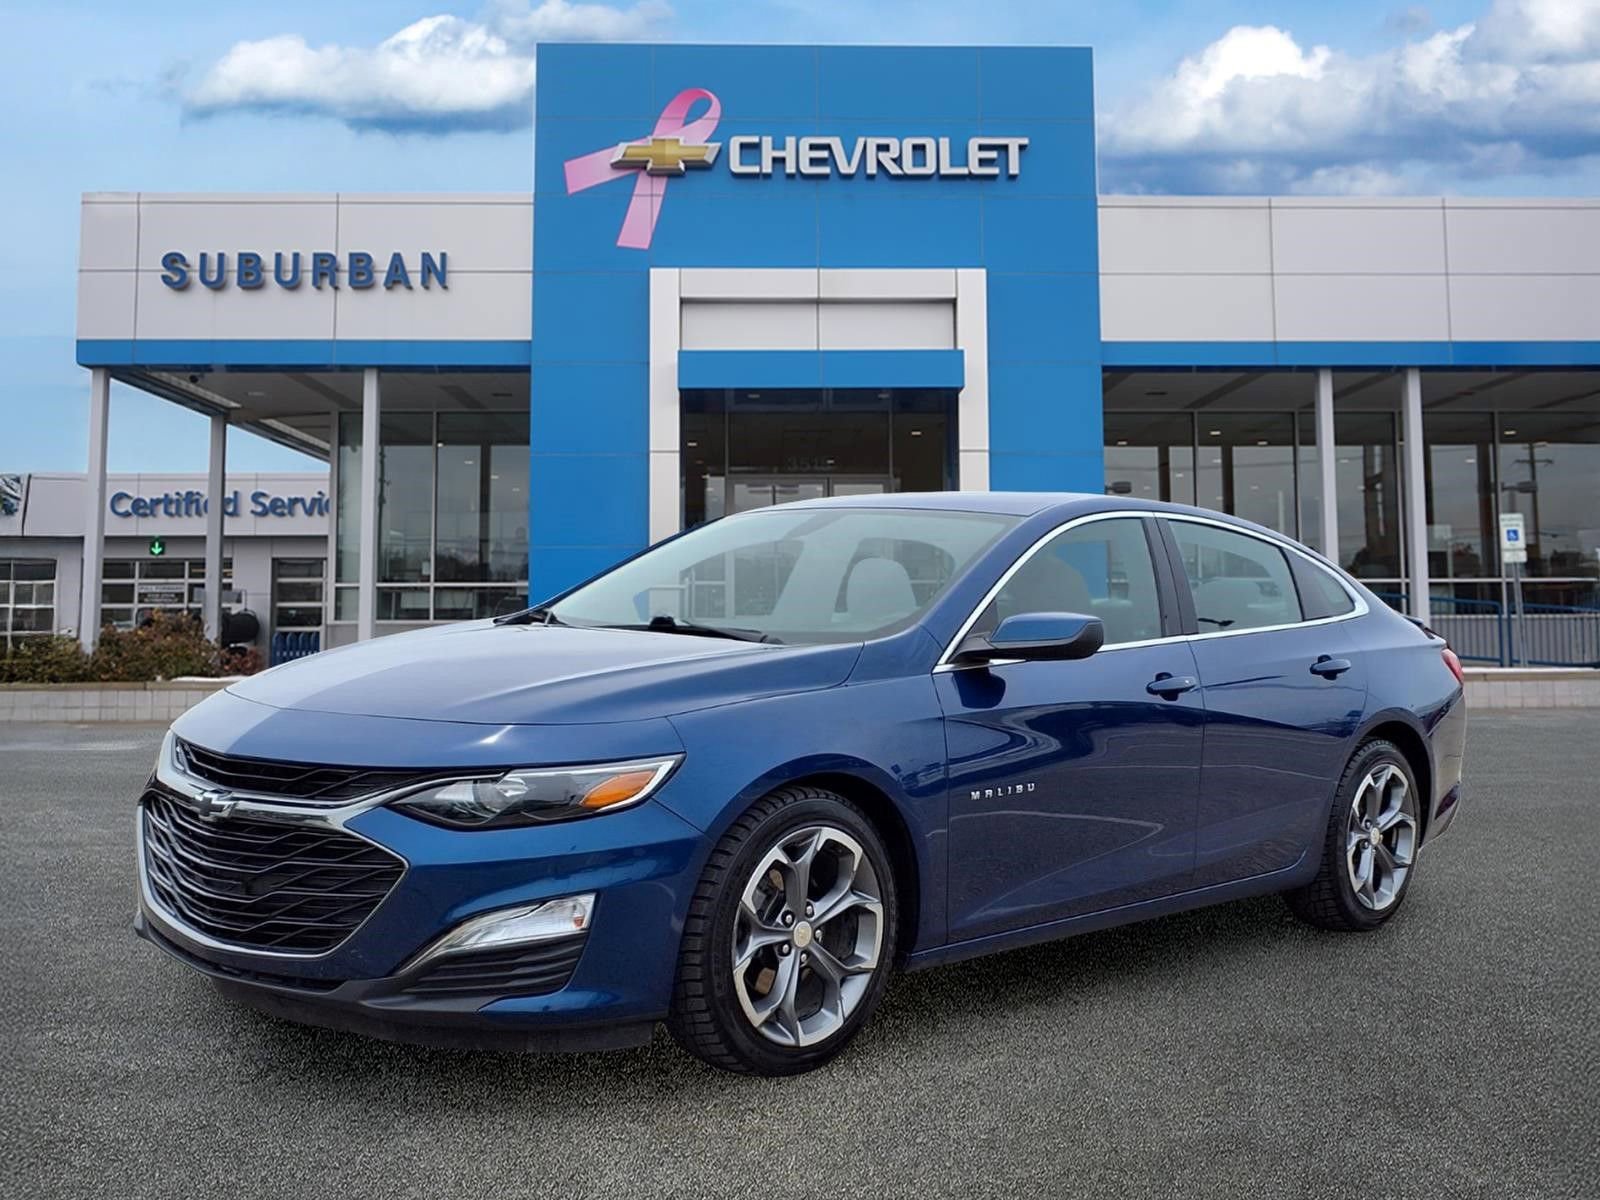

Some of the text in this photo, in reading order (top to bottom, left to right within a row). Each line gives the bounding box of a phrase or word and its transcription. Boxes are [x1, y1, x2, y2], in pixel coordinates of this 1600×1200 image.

[729, 135, 1029, 177] CHEVROLET
[160, 251, 449, 290] SUBURBAN
[110, 491, 241, 517] Certifid
[970, 783, 1035, 801] MALIBU
